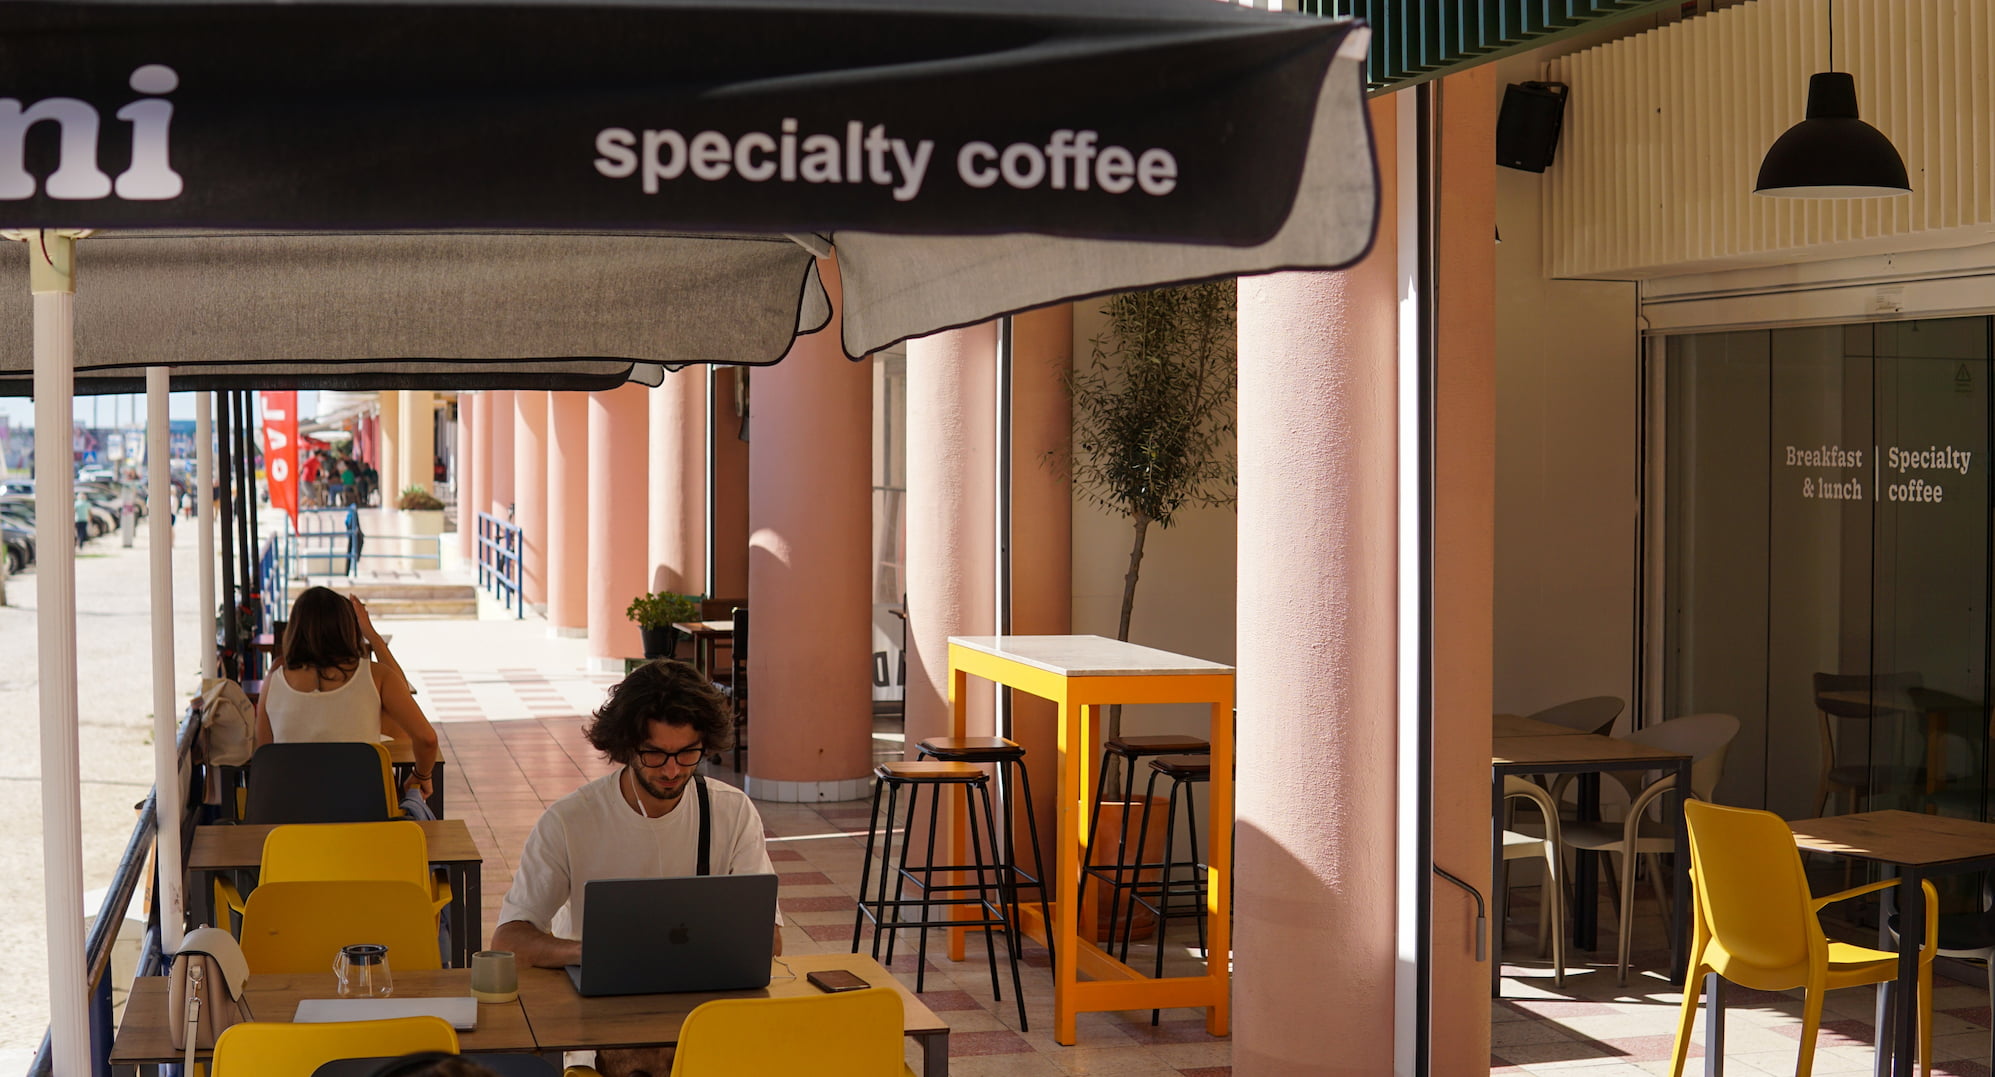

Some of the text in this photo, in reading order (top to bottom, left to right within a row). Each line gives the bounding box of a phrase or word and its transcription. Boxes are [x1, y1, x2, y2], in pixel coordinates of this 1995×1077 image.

[594, 118, 1178, 201] specialty coffee
[1786, 445, 1863, 468] Breakfast
[1888, 446, 1972, 475] Specialty
[1803, 477, 1863, 500] & lunch
[1888, 479, 1943, 504] coffee
